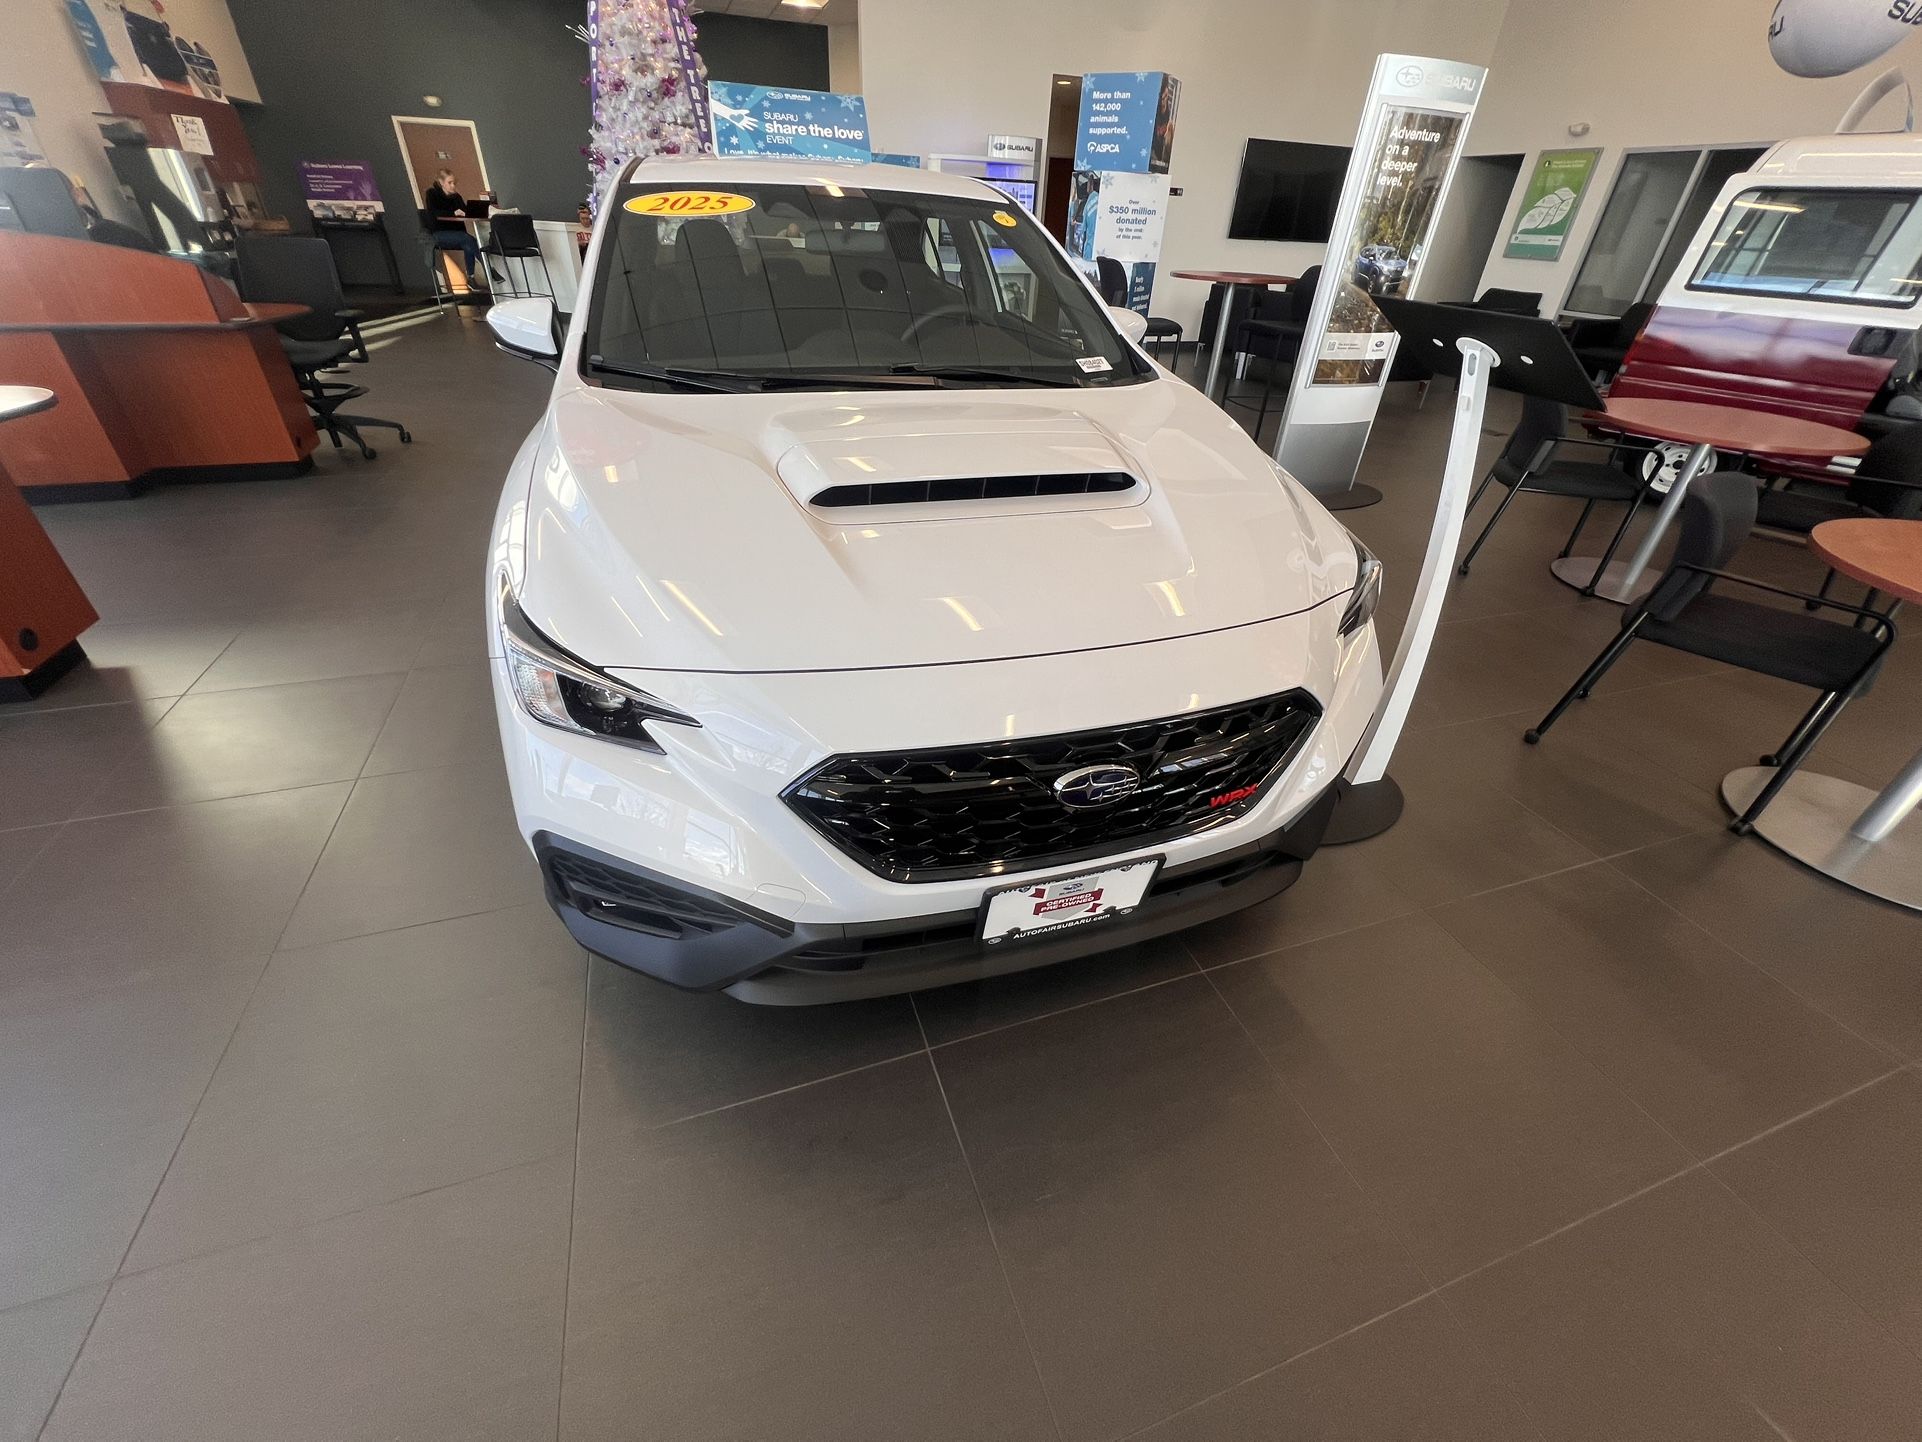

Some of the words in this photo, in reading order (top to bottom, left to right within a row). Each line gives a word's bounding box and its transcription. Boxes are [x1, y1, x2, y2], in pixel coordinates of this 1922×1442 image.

[671, 8, 691, 61] THE
[686, 70, 708, 133] TREE
[1425, 73, 1477, 91] SBARU
[1092, 91, 1112, 99] More
[1113, 91, 1131, 99] than
[1091, 103, 1121, 111] 142,000
[763, 111, 799, 122] SUBARU
[765, 121, 807, 135] share
[809, 123, 834, 138] the
[834, 125, 863, 140] love
[1088, 126, 1128, 135] supported.
[1389, 126, 1441, 143] Adventure
[766, 135, 794, 145] EVENT
[1007, 144, 1034, 152] SUBARU
[1095, 144, 1120, 153] ASPCA
[1385, 144, 1399, 155] on
[1401, 145, 1410, 155] a
[1381, 160, 1418, 173] deeper
[1376, 173, 1403, 187] level.
[646, 196, 733, 212] 2025
[1109, 205, 1130, 215] $350
[1131, 206, 1157, 216] million
[1116, 216, 1147, 225] donated
[1210, 783, 1258, 808] WRX
[1040, 896, 1095, 912] PRE-OWNED
[1046, 893, 1092, 907] CERTIFIED
[1013, 913, 1111, 940] AUTOFAIRSUBARU.com
